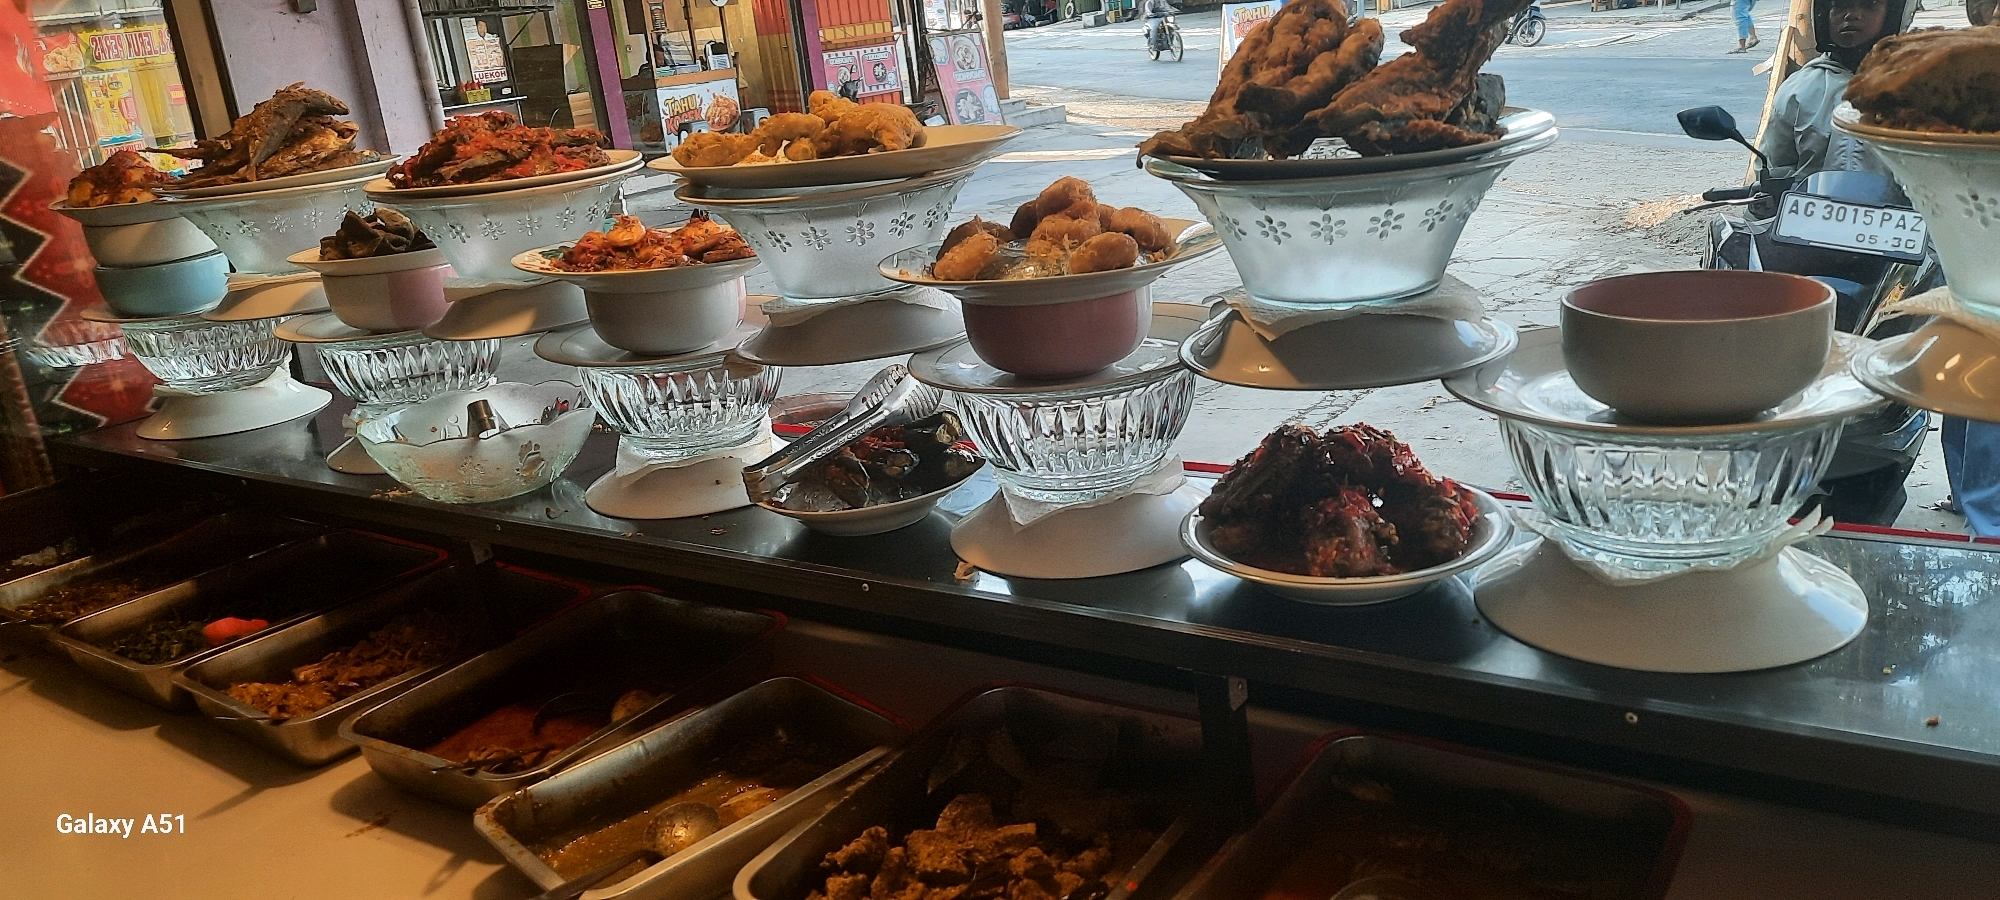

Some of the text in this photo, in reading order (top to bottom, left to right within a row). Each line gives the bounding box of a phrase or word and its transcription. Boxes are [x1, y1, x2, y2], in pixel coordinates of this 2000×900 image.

[1234, 4, 1270, 23] TAHU
[473, 71, 507, 81] LUEKOH
[664, 93, 698, 116] TAHU
[1787, 199, 1924, 232] AG 3015 PAZ
